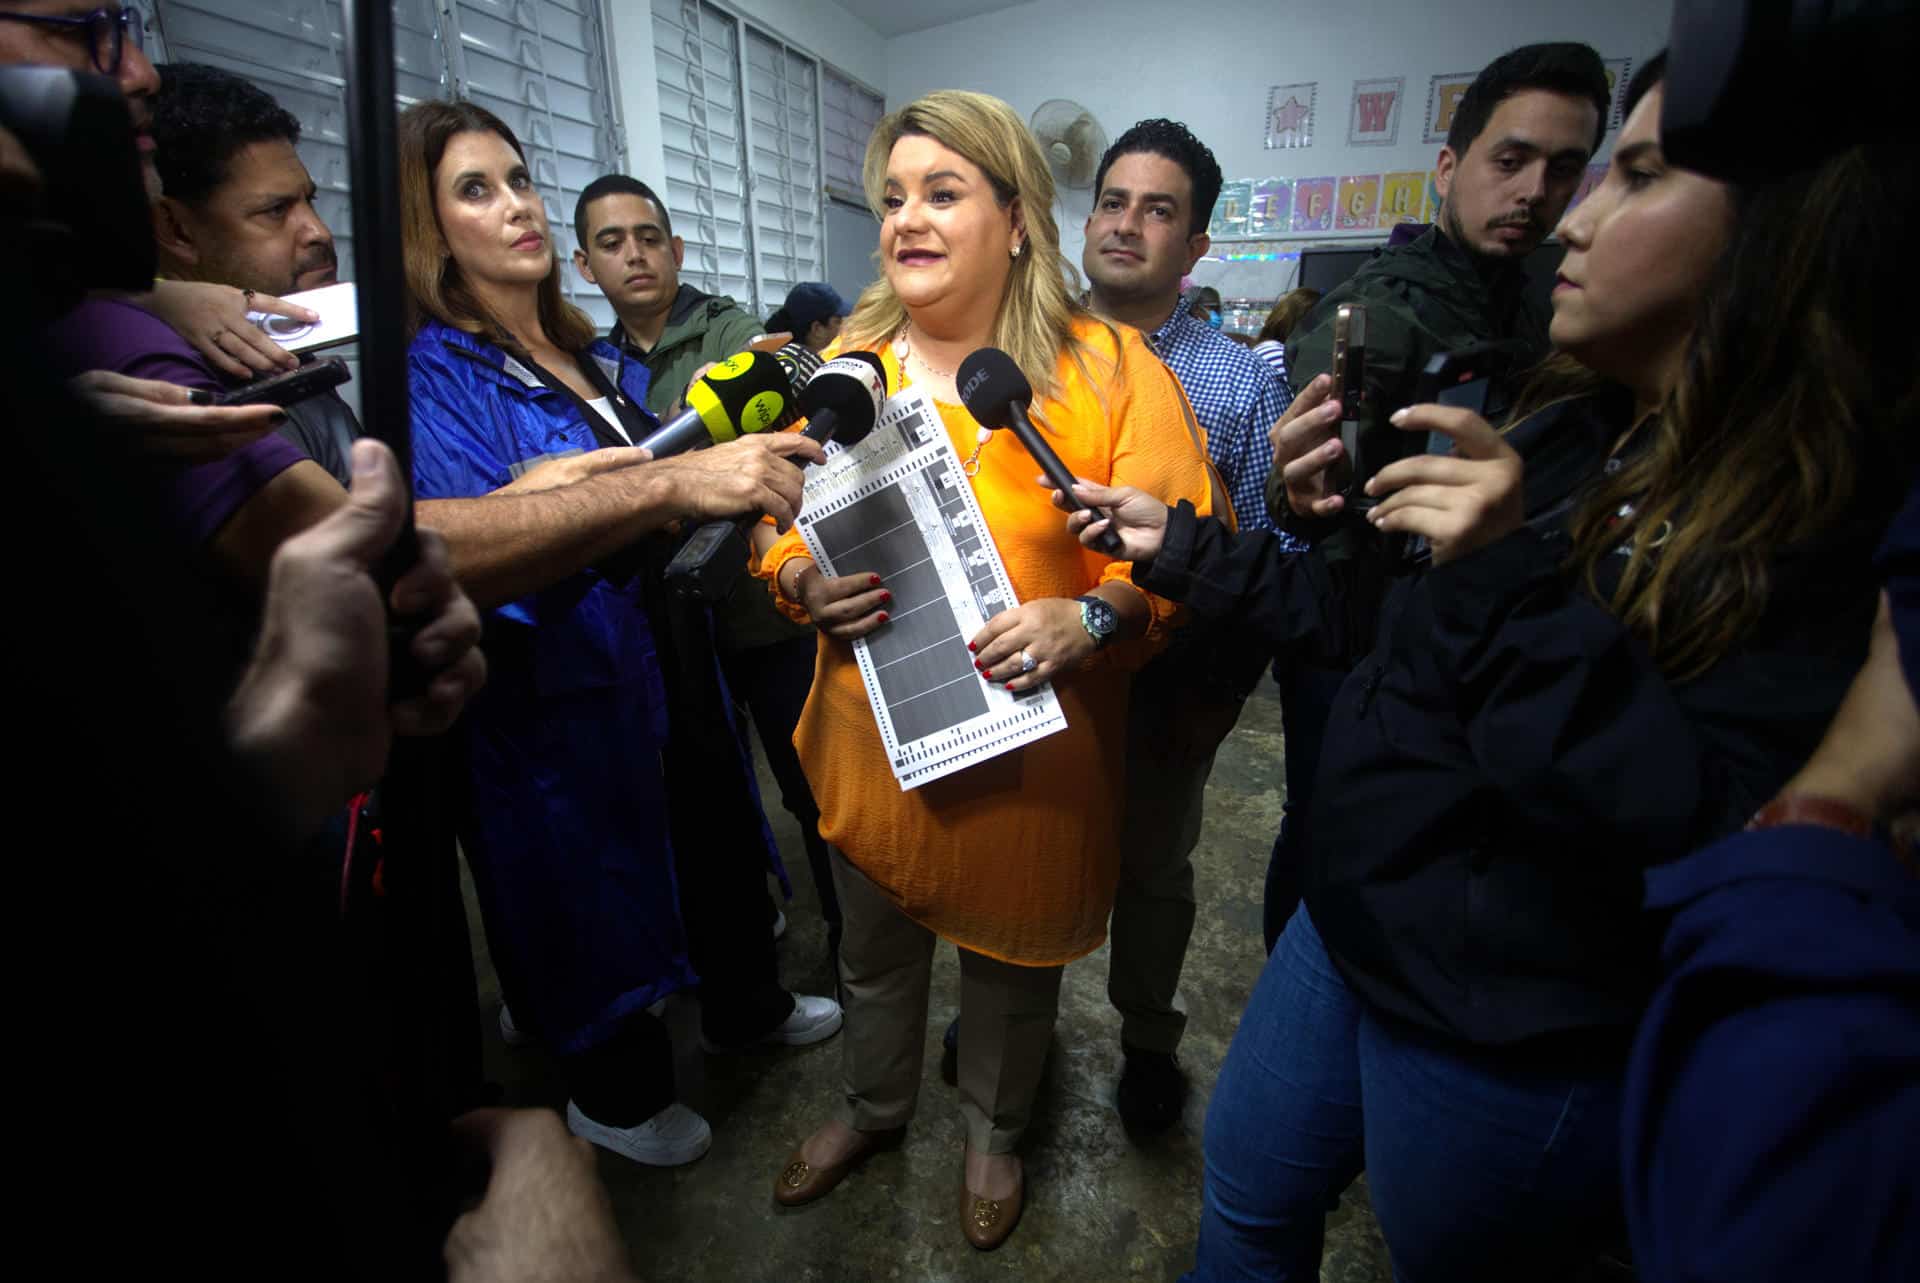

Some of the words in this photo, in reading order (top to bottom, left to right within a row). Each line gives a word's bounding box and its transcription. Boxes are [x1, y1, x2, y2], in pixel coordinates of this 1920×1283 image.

[1357, 91, 1396, 132] W
[1265, 194, 1281, 219] E
[1308, 192, 1323, 218] F
[1350, 189, 1367, 216] G
[1391, 187, 1411, 213] H
